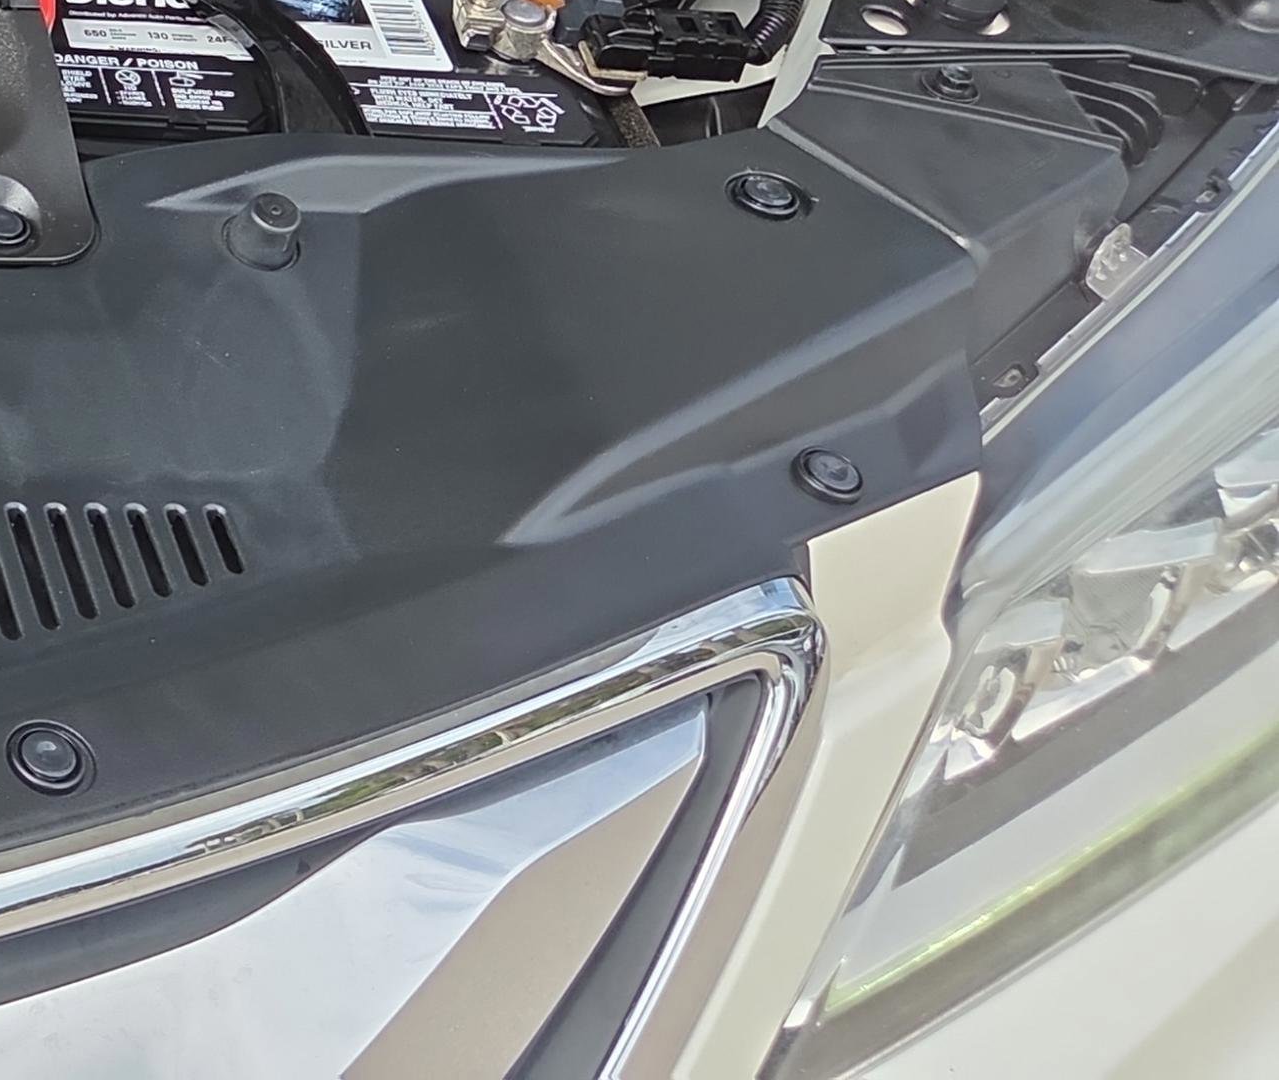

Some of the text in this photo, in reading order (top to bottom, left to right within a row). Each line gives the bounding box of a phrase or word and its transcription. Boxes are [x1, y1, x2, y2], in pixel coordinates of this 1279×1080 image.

[84, 28, 107, 38] 650
[148, 31, 168, 41] 130
[54, 53, 120, 67] DANGER
[137, 57, 200, 70] POISON
